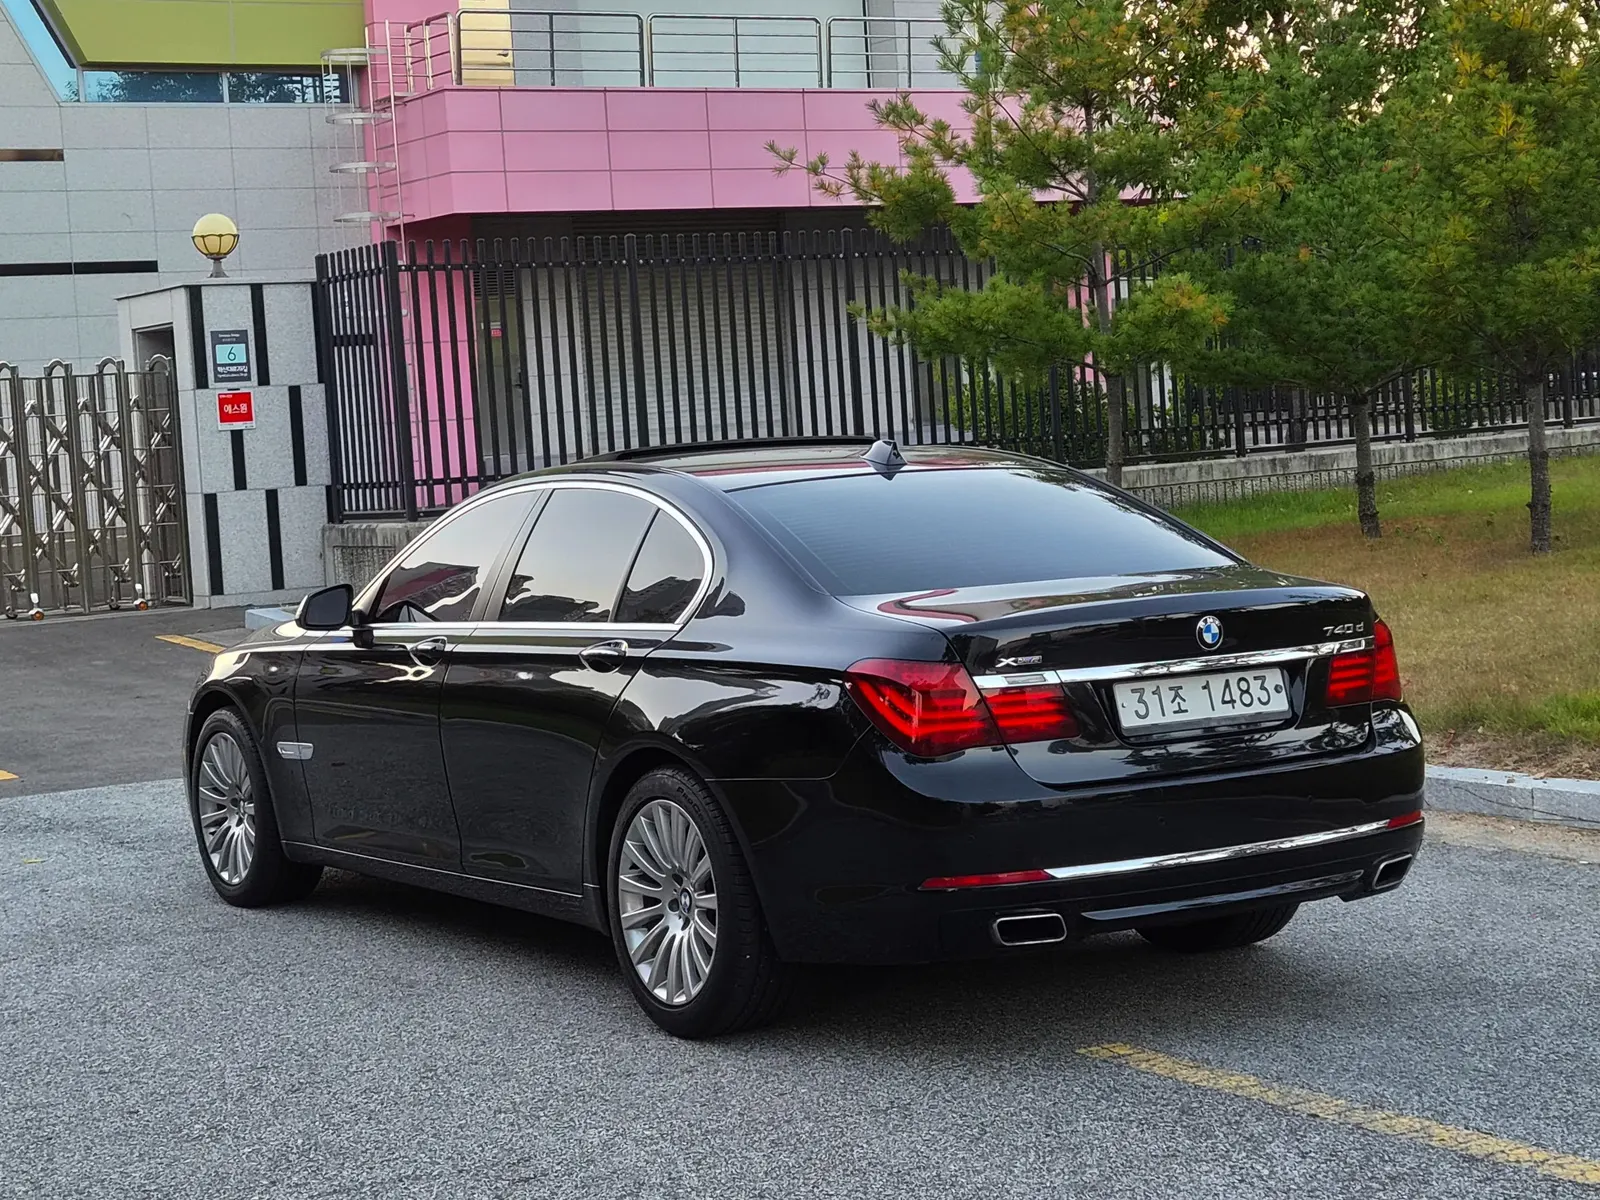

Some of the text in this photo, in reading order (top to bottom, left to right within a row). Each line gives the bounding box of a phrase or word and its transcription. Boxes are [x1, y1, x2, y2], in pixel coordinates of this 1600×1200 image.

[227, 346, 236, 361] 6
[223, 403, 248, 414] 에스원
[1130, 675, 1271, 720] 31조 1483
